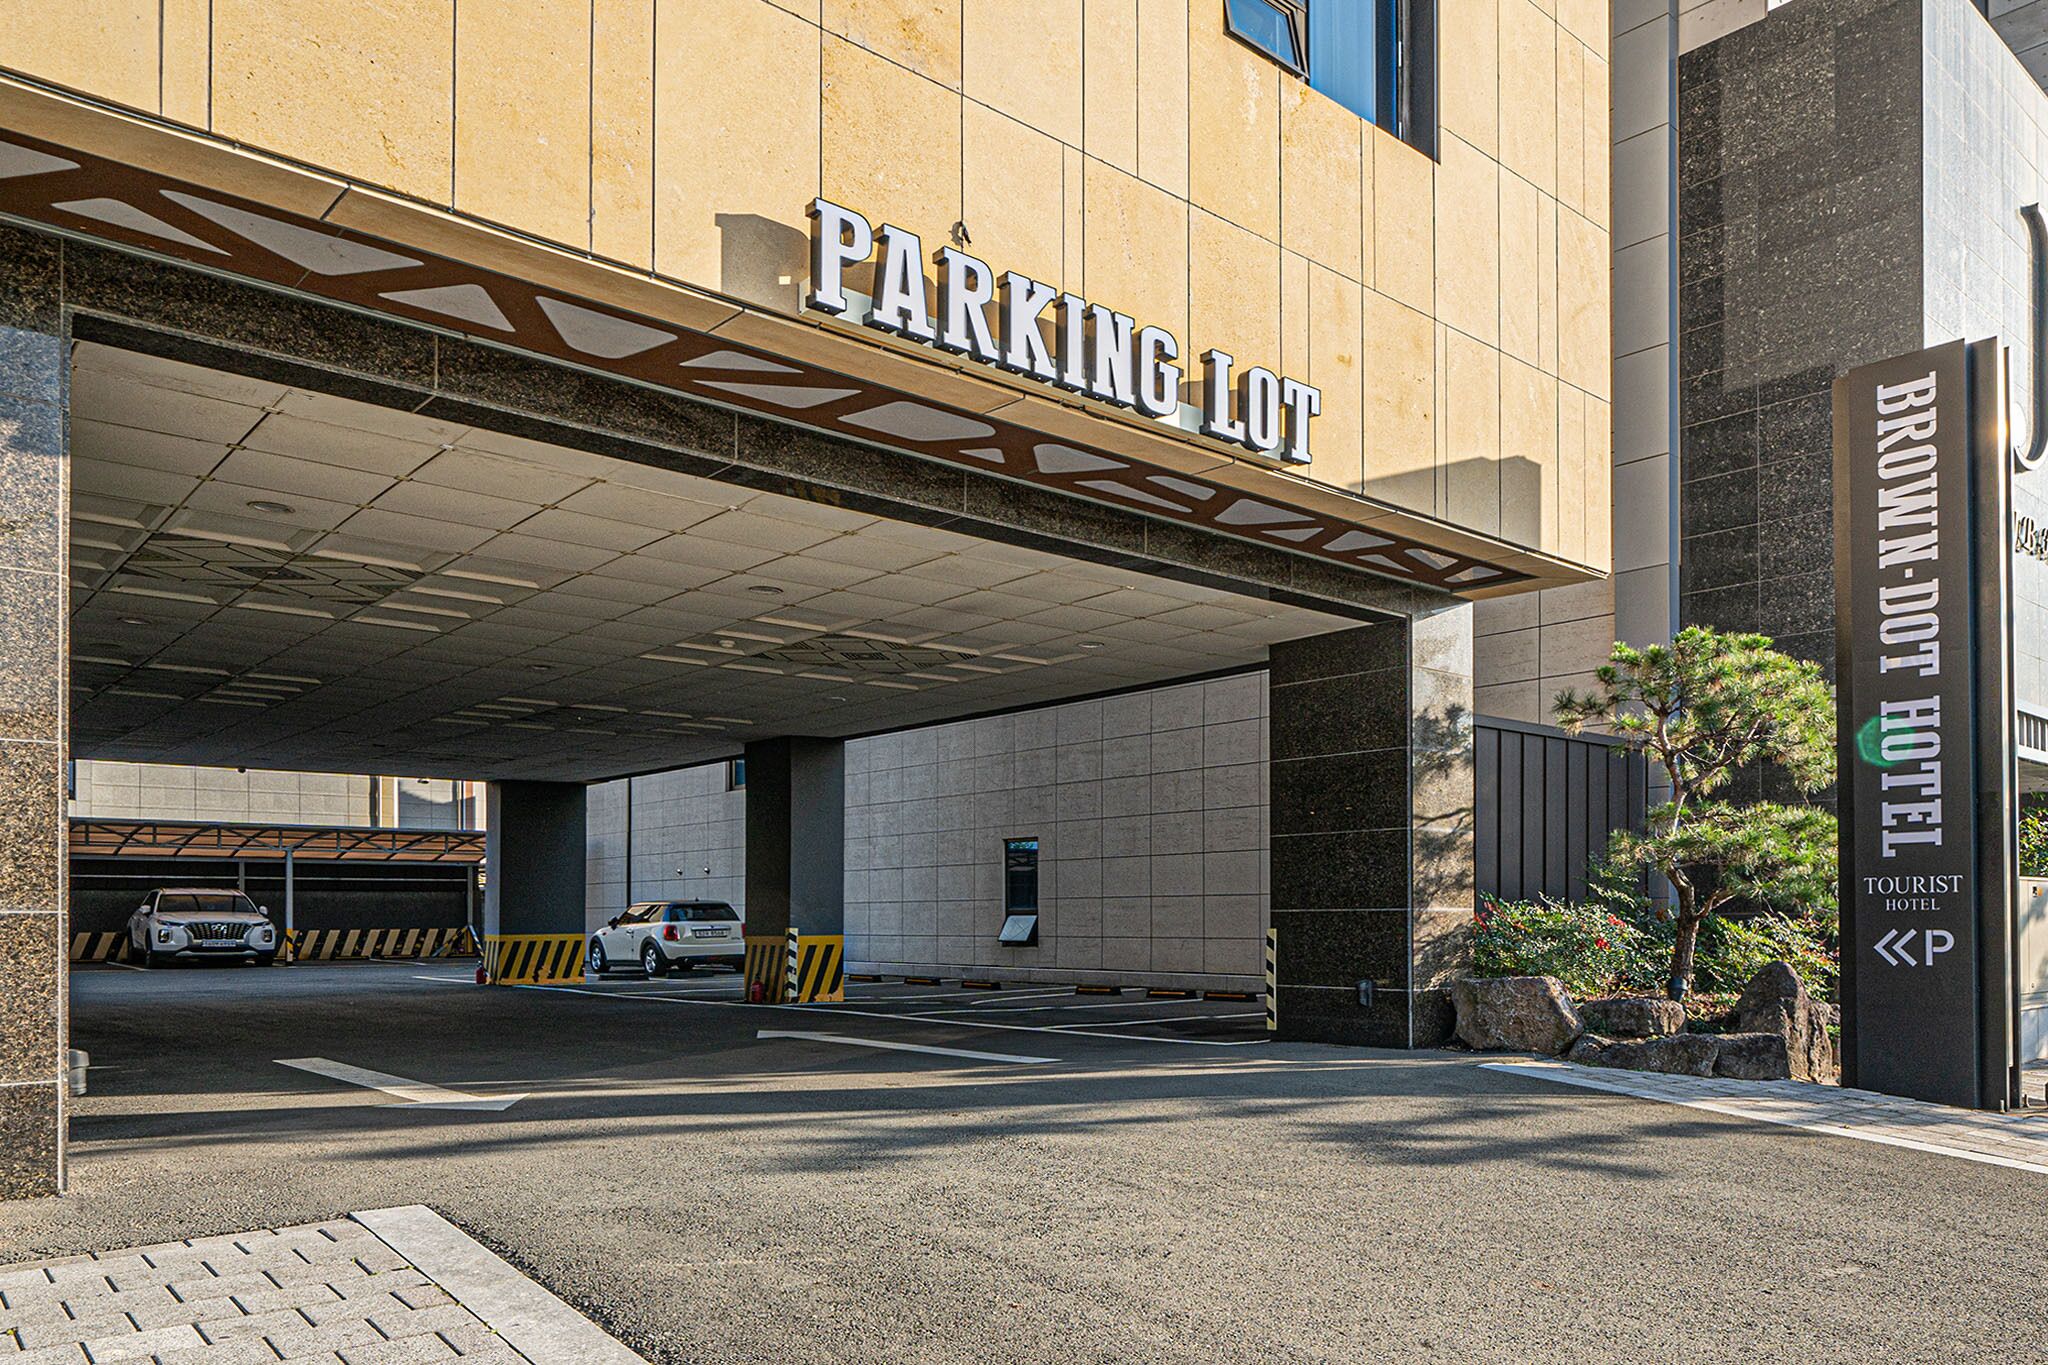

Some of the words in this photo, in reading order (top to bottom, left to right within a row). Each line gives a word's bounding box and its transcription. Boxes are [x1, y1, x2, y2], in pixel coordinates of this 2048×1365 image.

[806, 198, 1184, 418] PARKING
[1200, 348, 1321, 464] LOT
[1876, 371, 1941, 678] BROWN-DOT
[1880, 695, 1943, 858] HOTEL
[1863, 874, 1964, 895] TOURIST
[1885, 898, 1941, 911] HOTEL
[1925, 929, 1955, 966] P
